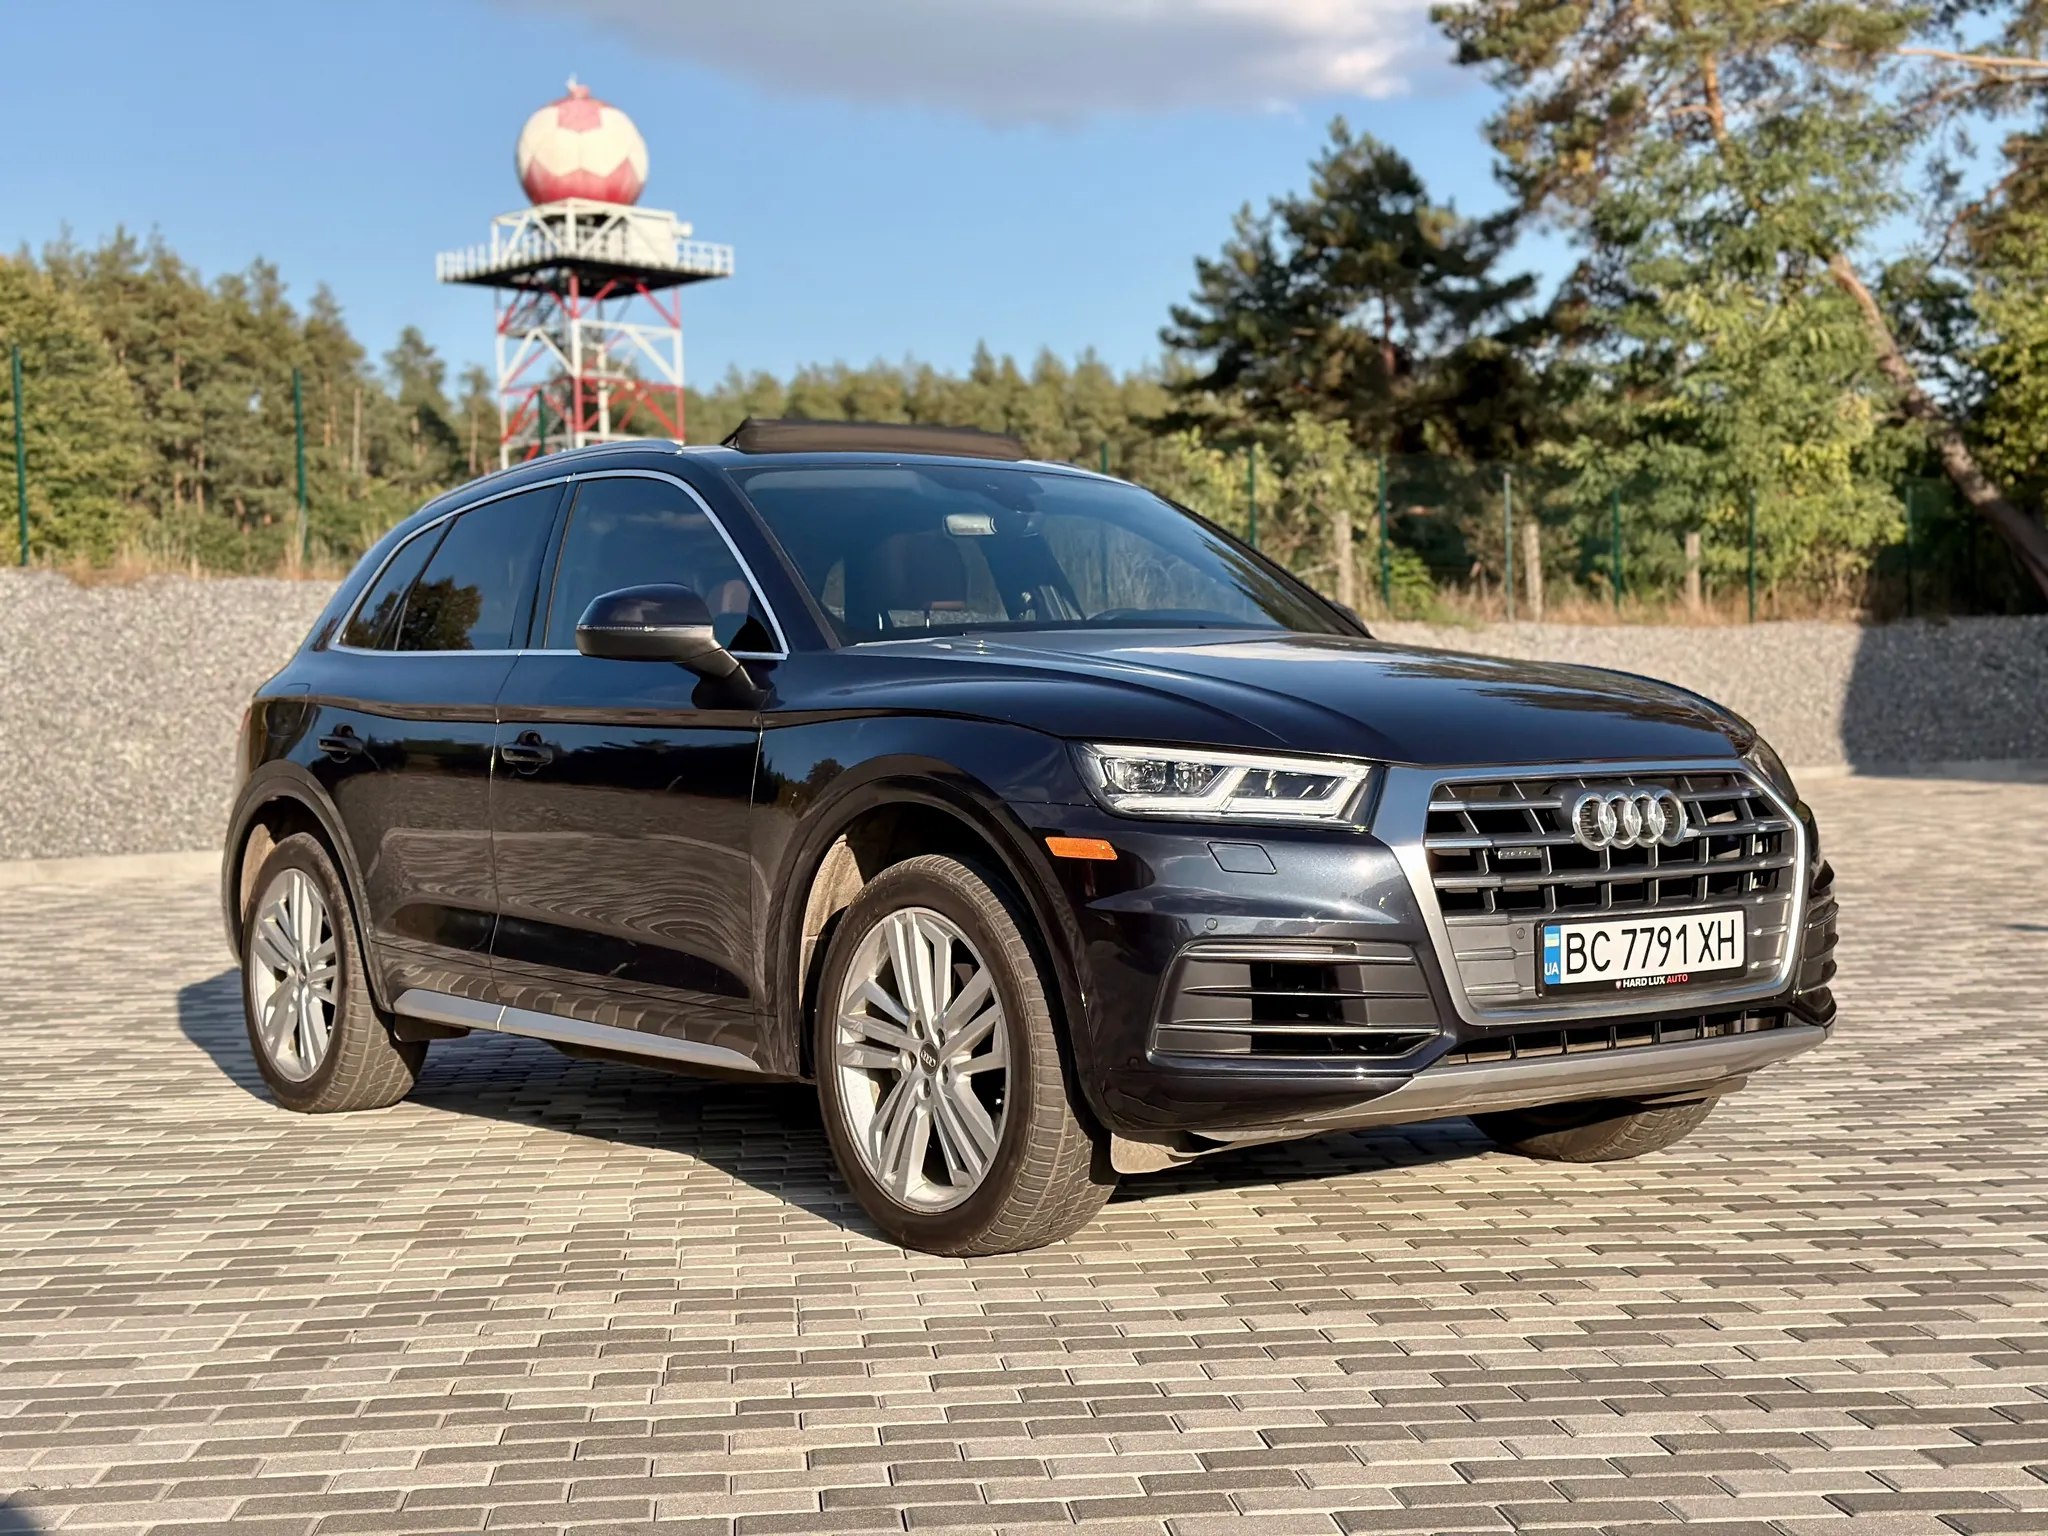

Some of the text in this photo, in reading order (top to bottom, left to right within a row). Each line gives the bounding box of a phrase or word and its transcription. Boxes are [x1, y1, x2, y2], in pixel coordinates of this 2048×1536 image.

[1566, 919, 1735, 975] BC 7791 XH
[1544, 962, 1559, 976] UA
[1622, 974, 1688, 988] HARD LUX AUTO
